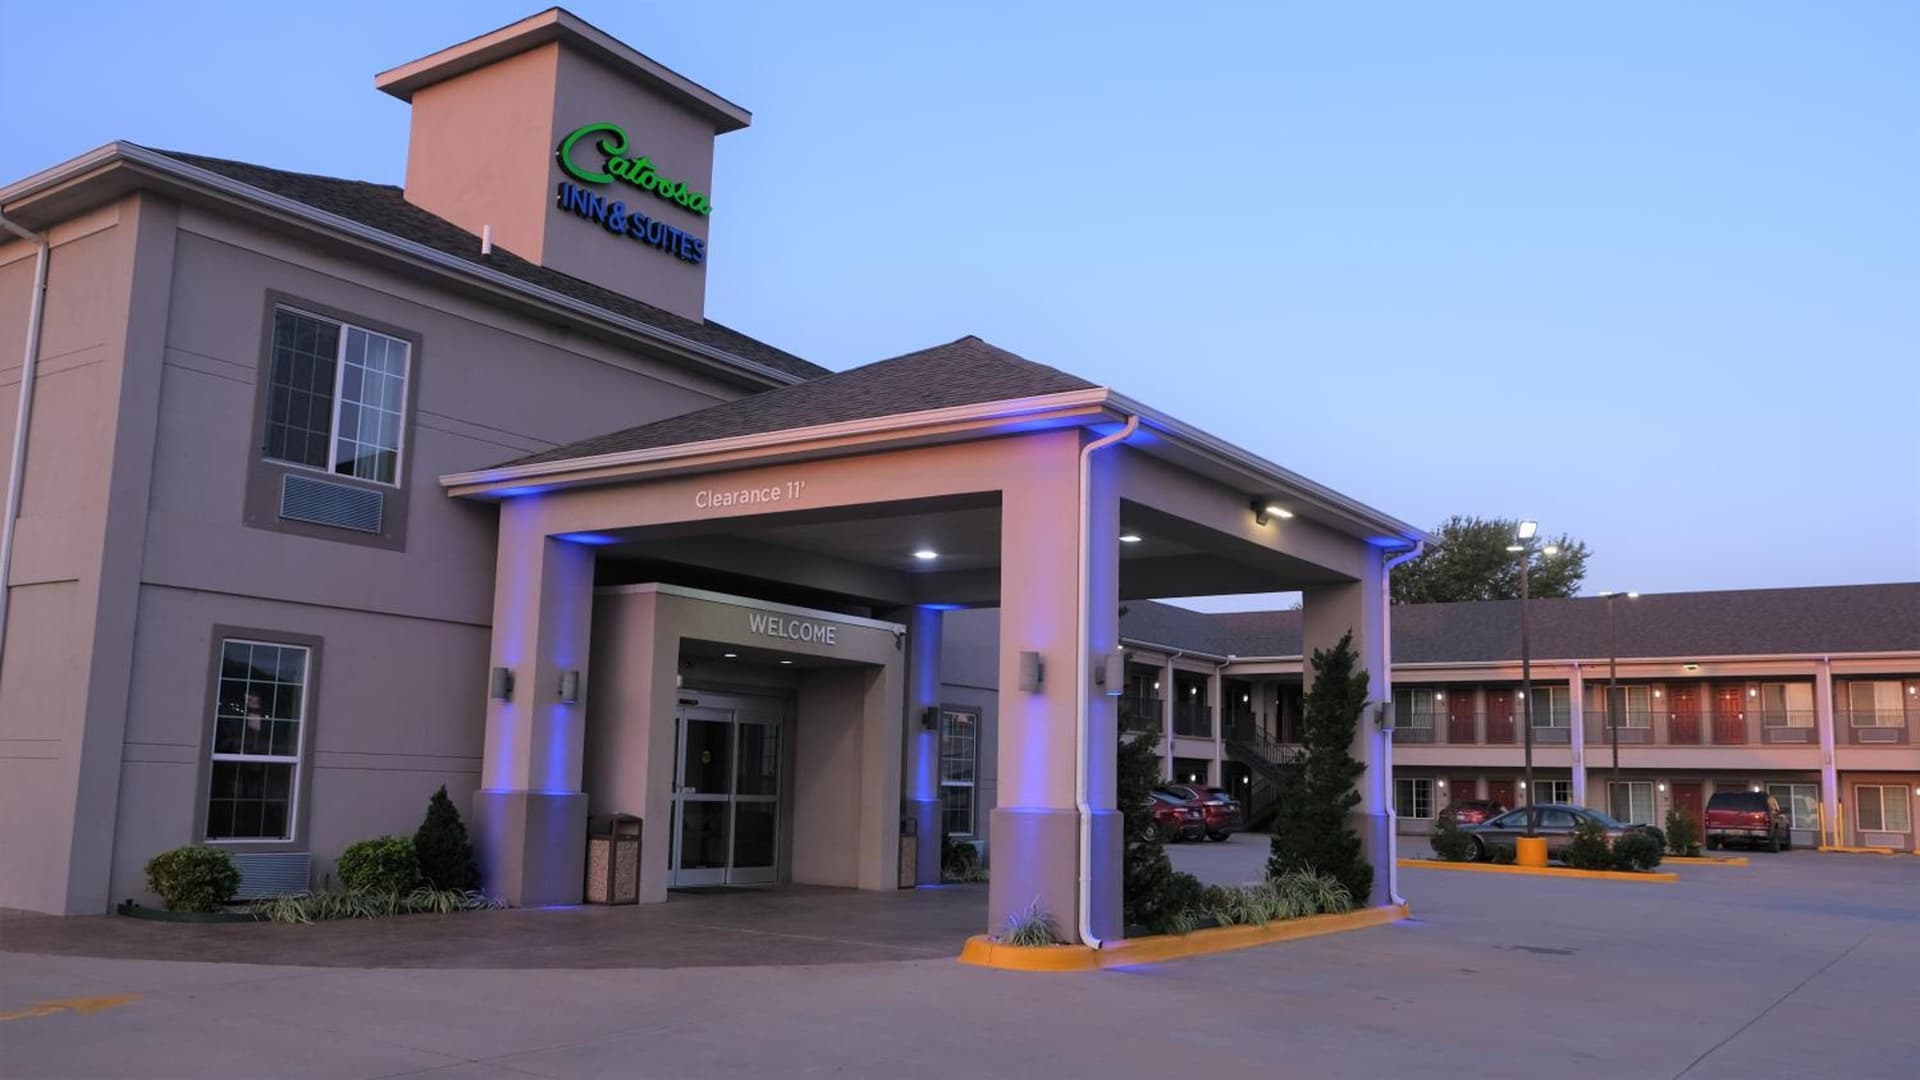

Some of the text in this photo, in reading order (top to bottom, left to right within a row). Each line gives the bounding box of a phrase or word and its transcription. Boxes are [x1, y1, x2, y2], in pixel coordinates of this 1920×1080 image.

[559, 122, 712, 216] Catoosa
[561, 182, 705, 264] INN & SUITES
[695, 486, 781, 508] Clearance
[749, 613, 837, 644] WELCOME
